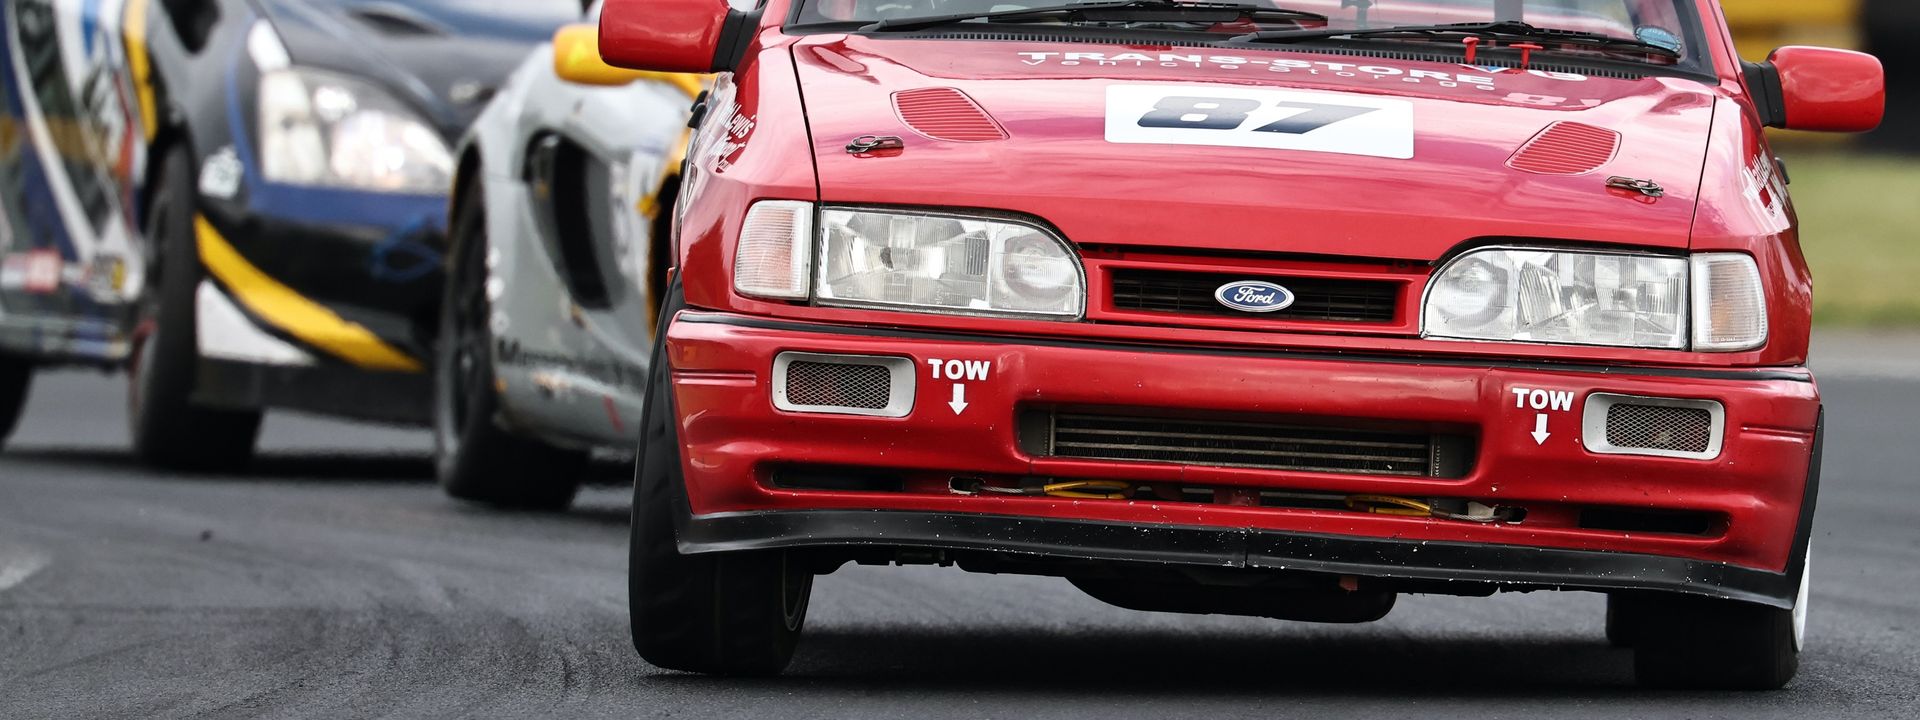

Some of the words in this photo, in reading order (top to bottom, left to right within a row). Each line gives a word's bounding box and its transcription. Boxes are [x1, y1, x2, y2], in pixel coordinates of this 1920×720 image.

[1018, 51, 1495, 86] TRANS-STORE
[1137, 95, 1380, 135] 87
[1233, 286, 1276, 304] Ford
[928, 358, 991, 382] TOW
[1512, 387, 1575, 412] TOW
